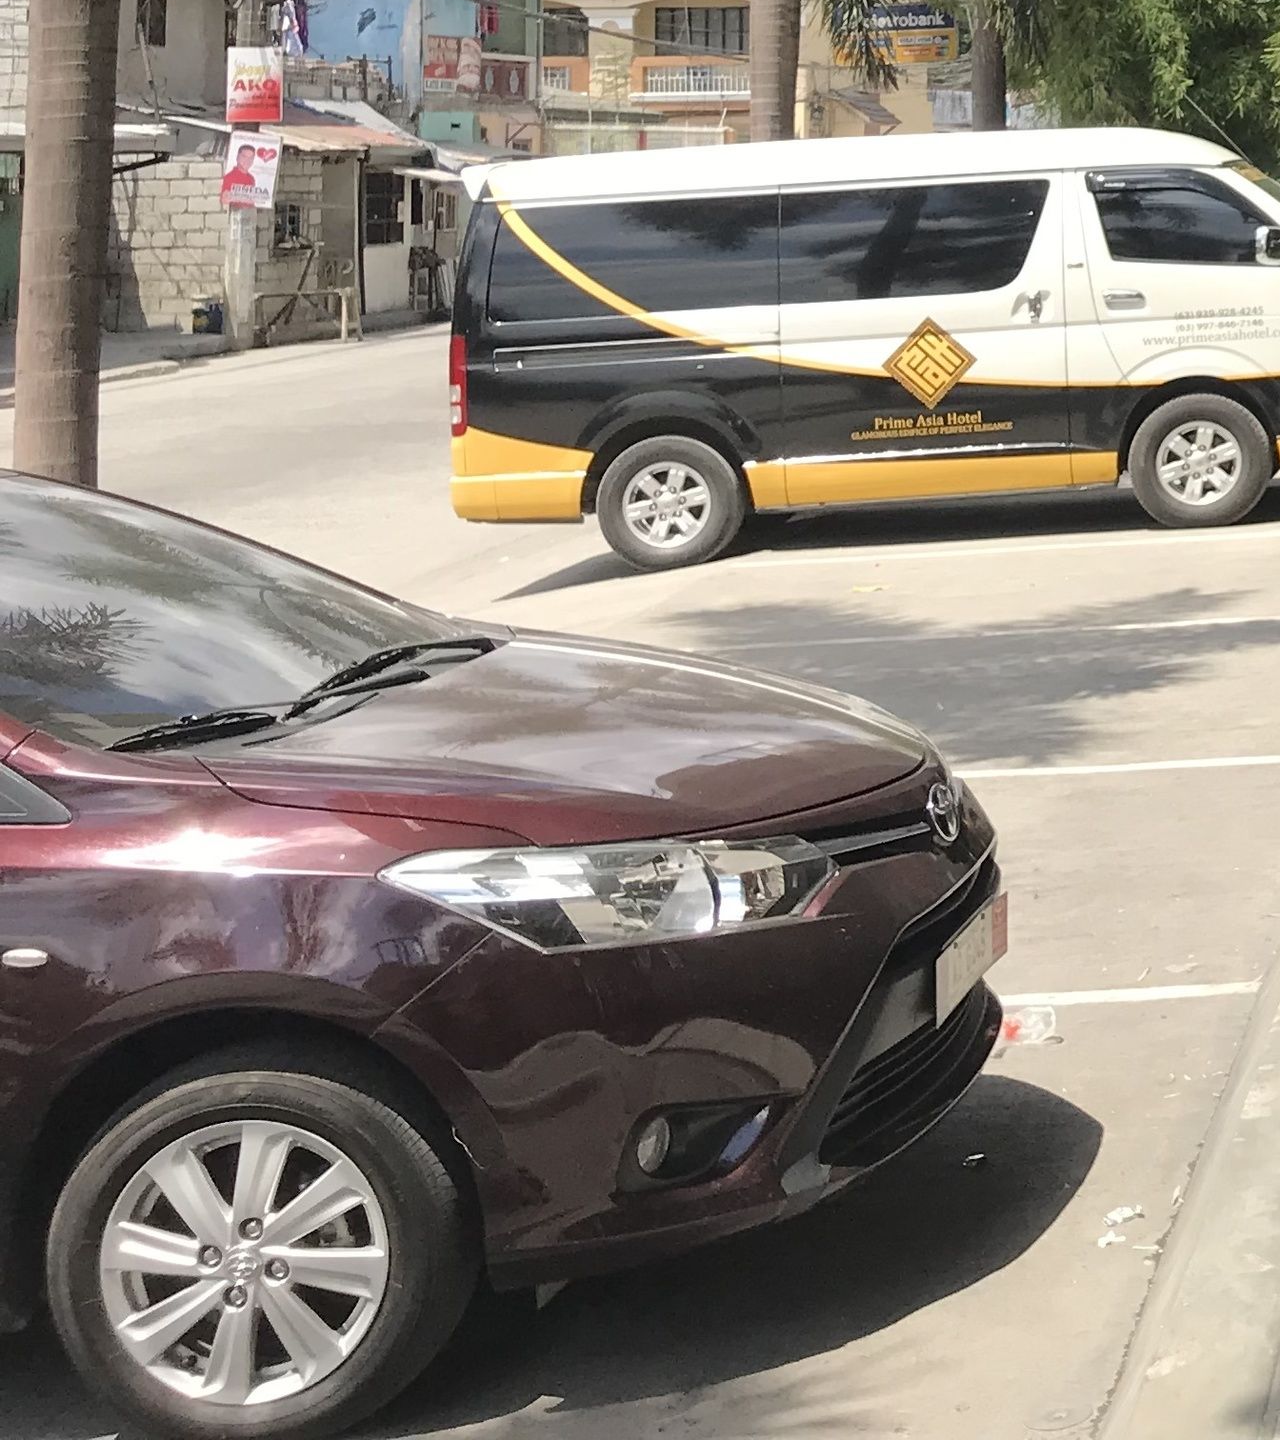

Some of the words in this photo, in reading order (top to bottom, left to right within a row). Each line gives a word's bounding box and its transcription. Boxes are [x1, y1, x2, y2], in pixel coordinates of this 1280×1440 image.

[874, 415, 914, 430] Prime
[916, 412, 944, 427] Asia
[947, 410, 982, 425] Hotel
[928, 426, 939, 435] OF
